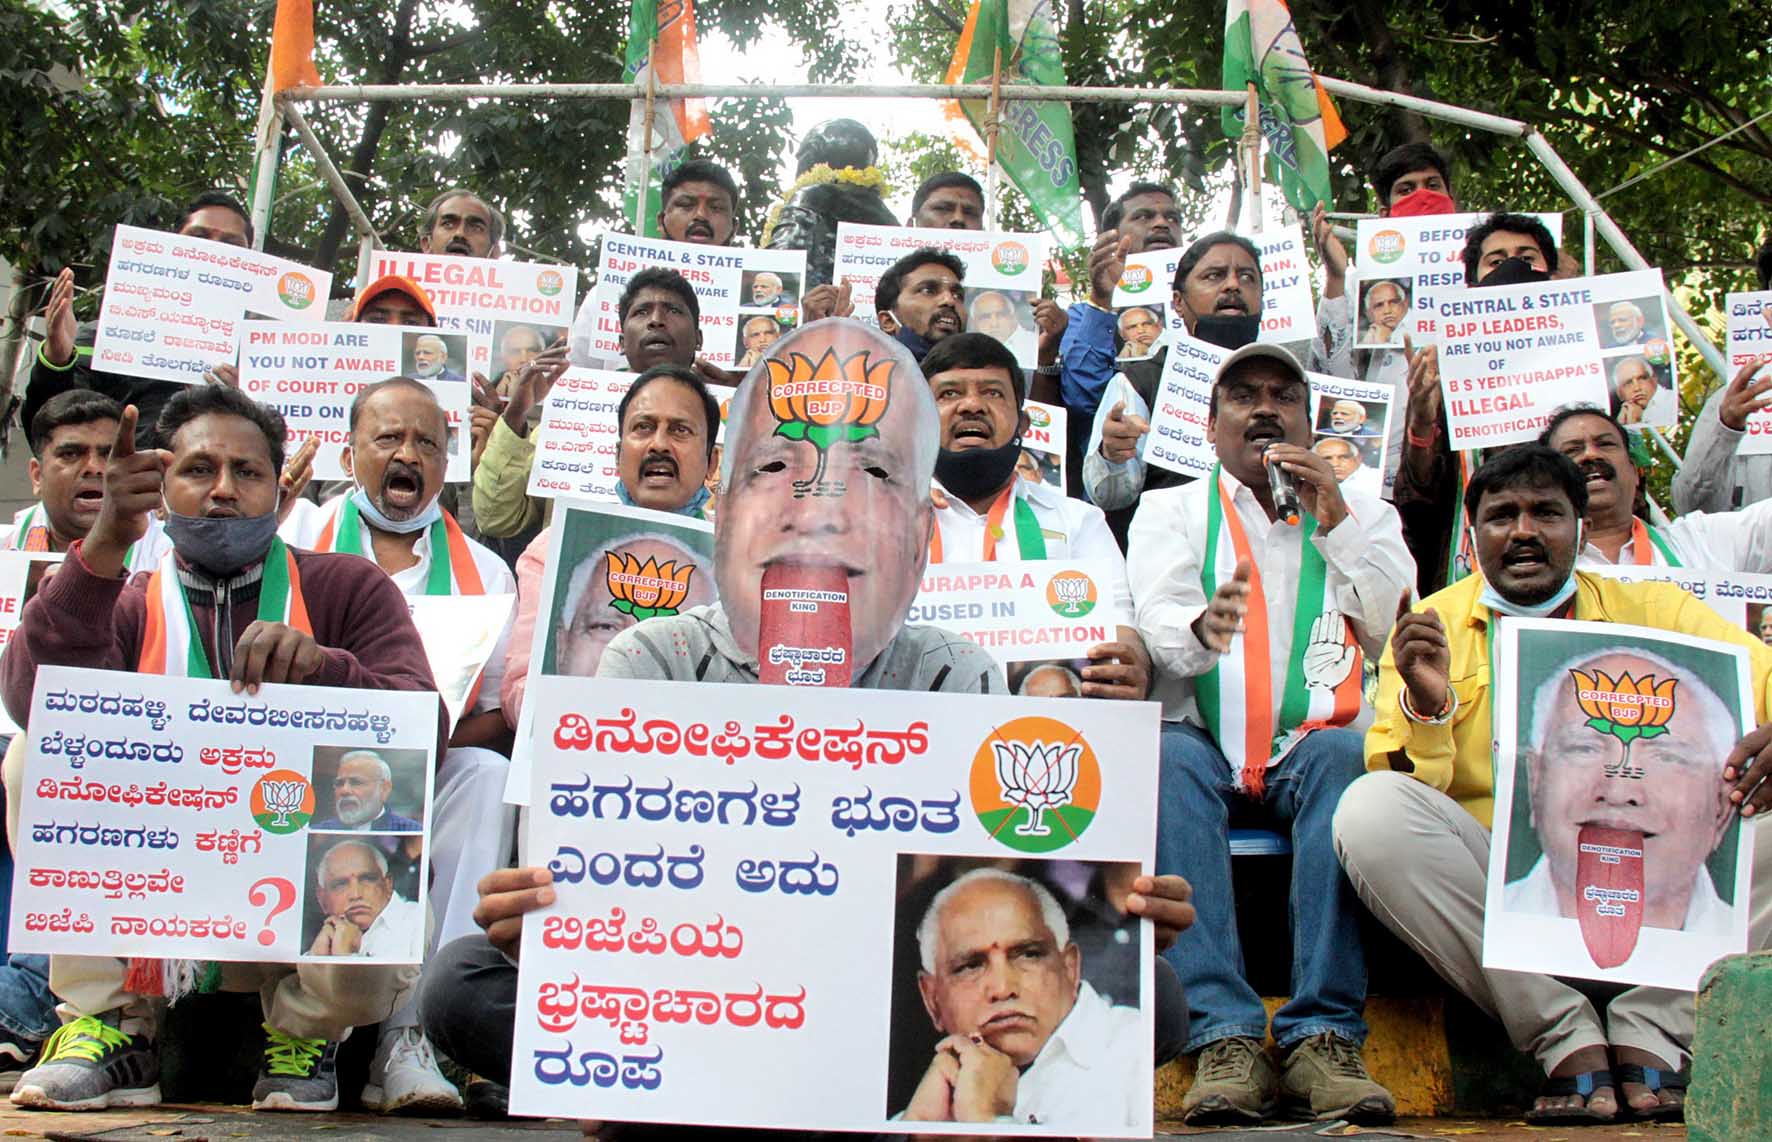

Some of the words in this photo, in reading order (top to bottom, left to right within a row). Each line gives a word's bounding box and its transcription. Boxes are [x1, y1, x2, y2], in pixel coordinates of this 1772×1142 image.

[606, 240, 676, 263] CENTRAL
[680, 251, 692, 264] &
[696, 253, 744, 269] STATE
[608, 257, 637, 273] BJP
[1418, 251, 1441, 265] TO
[377, 258, 505, 290] ILLEGAL
[603, 272, 628, 287] ARE
[694, 285, 729, 298] WARE
[422, 288, 562, 316] OTIFICATION
[1440, 297, 1517, 318] CENTRAL
[1521, 295, 1535, 310] &
[1539, 289, 1592, 307] STATE
[1445, 321, 1478, 338] BJP
[1483, 314, 1565, 336] LEADERS,
[250, 331, 277, 345] PM
[282, 332, 329, 346] MODI
[333, 333, 369, 347] ARE
[1445, 344, 1472, 356] ARE
[1474, 341, 1504, 354] YOU
[1506, 337, 1533, 351] NOT
[1537, 331, 1585, 347] AWARE
[249, 356, 285, 369] YOU
[291, 356, 329, 370] NOT
[334, 359, 396, 373] AWARE
[1488, 358, 1506, 371] OF
[248, 379, 271, 392] OF
[276, 380, 338, 395] COURT
[772, 381, 886, 400] CORRECPTED
[1449, 380, 1459, 394] B
[1463, 378, 1473, 391] S
[1477, 363, 1601, 390] YEDIYURAPPA'S
[319, 405, 345, 419] ON
[808, 402, 843, 415] BJP
[1451, 391, 1536, 417] ILLEGAL
[609, 571, 687, 593] CORRECPTED
[919, 573, 1013, 593] URAPPA
[634, 591, 658, 601] BJP
[765, 590, 846, 602] DENOTIFICATION
[791, 602, 817, 612] KING
[907, 602, 984, 623] CUSED
[991, 600, 1016, 618] IN
[1580, 690, 1671, 708] CORRECPTED
[1612, 707, 1638, 719] BJP
[552, 707, 930, 771] ಡಿನೋಫಿಕೇಷನ್
[199, 743, 277, 776] ಅಕ್ರಮ
[35, 775, 240, 812] ಡಿನೋಫಿಕೇಷನ್
[549, 772, 802, 828] ಹಗರಣಗಳ
[831, 784, 962, 838] ಭೂತ
[31, 818, 180, 851] ಹಗರಣಗಳು
[193, 828, 264, 866] ಕಣ್ಣಿಗೆ
[547, 842, 706, 890] ಎಂದರೆ
[735, 849, 840, 897] ಅದು
[28, 865, 186, 901] ಕಾಣುತ್ತಿಲ್ಲವೇ
[24, 906, 96, 935] ಬಿಜೆಪಿ
[110, 911, 247, 941] ನಾಯಕರೇ
[541, 906, 744, 960] ಬಿಜೆಪಿಯ
[536, 971, 807, 1047] ಭ್ರಷ್ಟಾಚಾರದ
[533, 1039, 664, 1092] ರೂಪ
